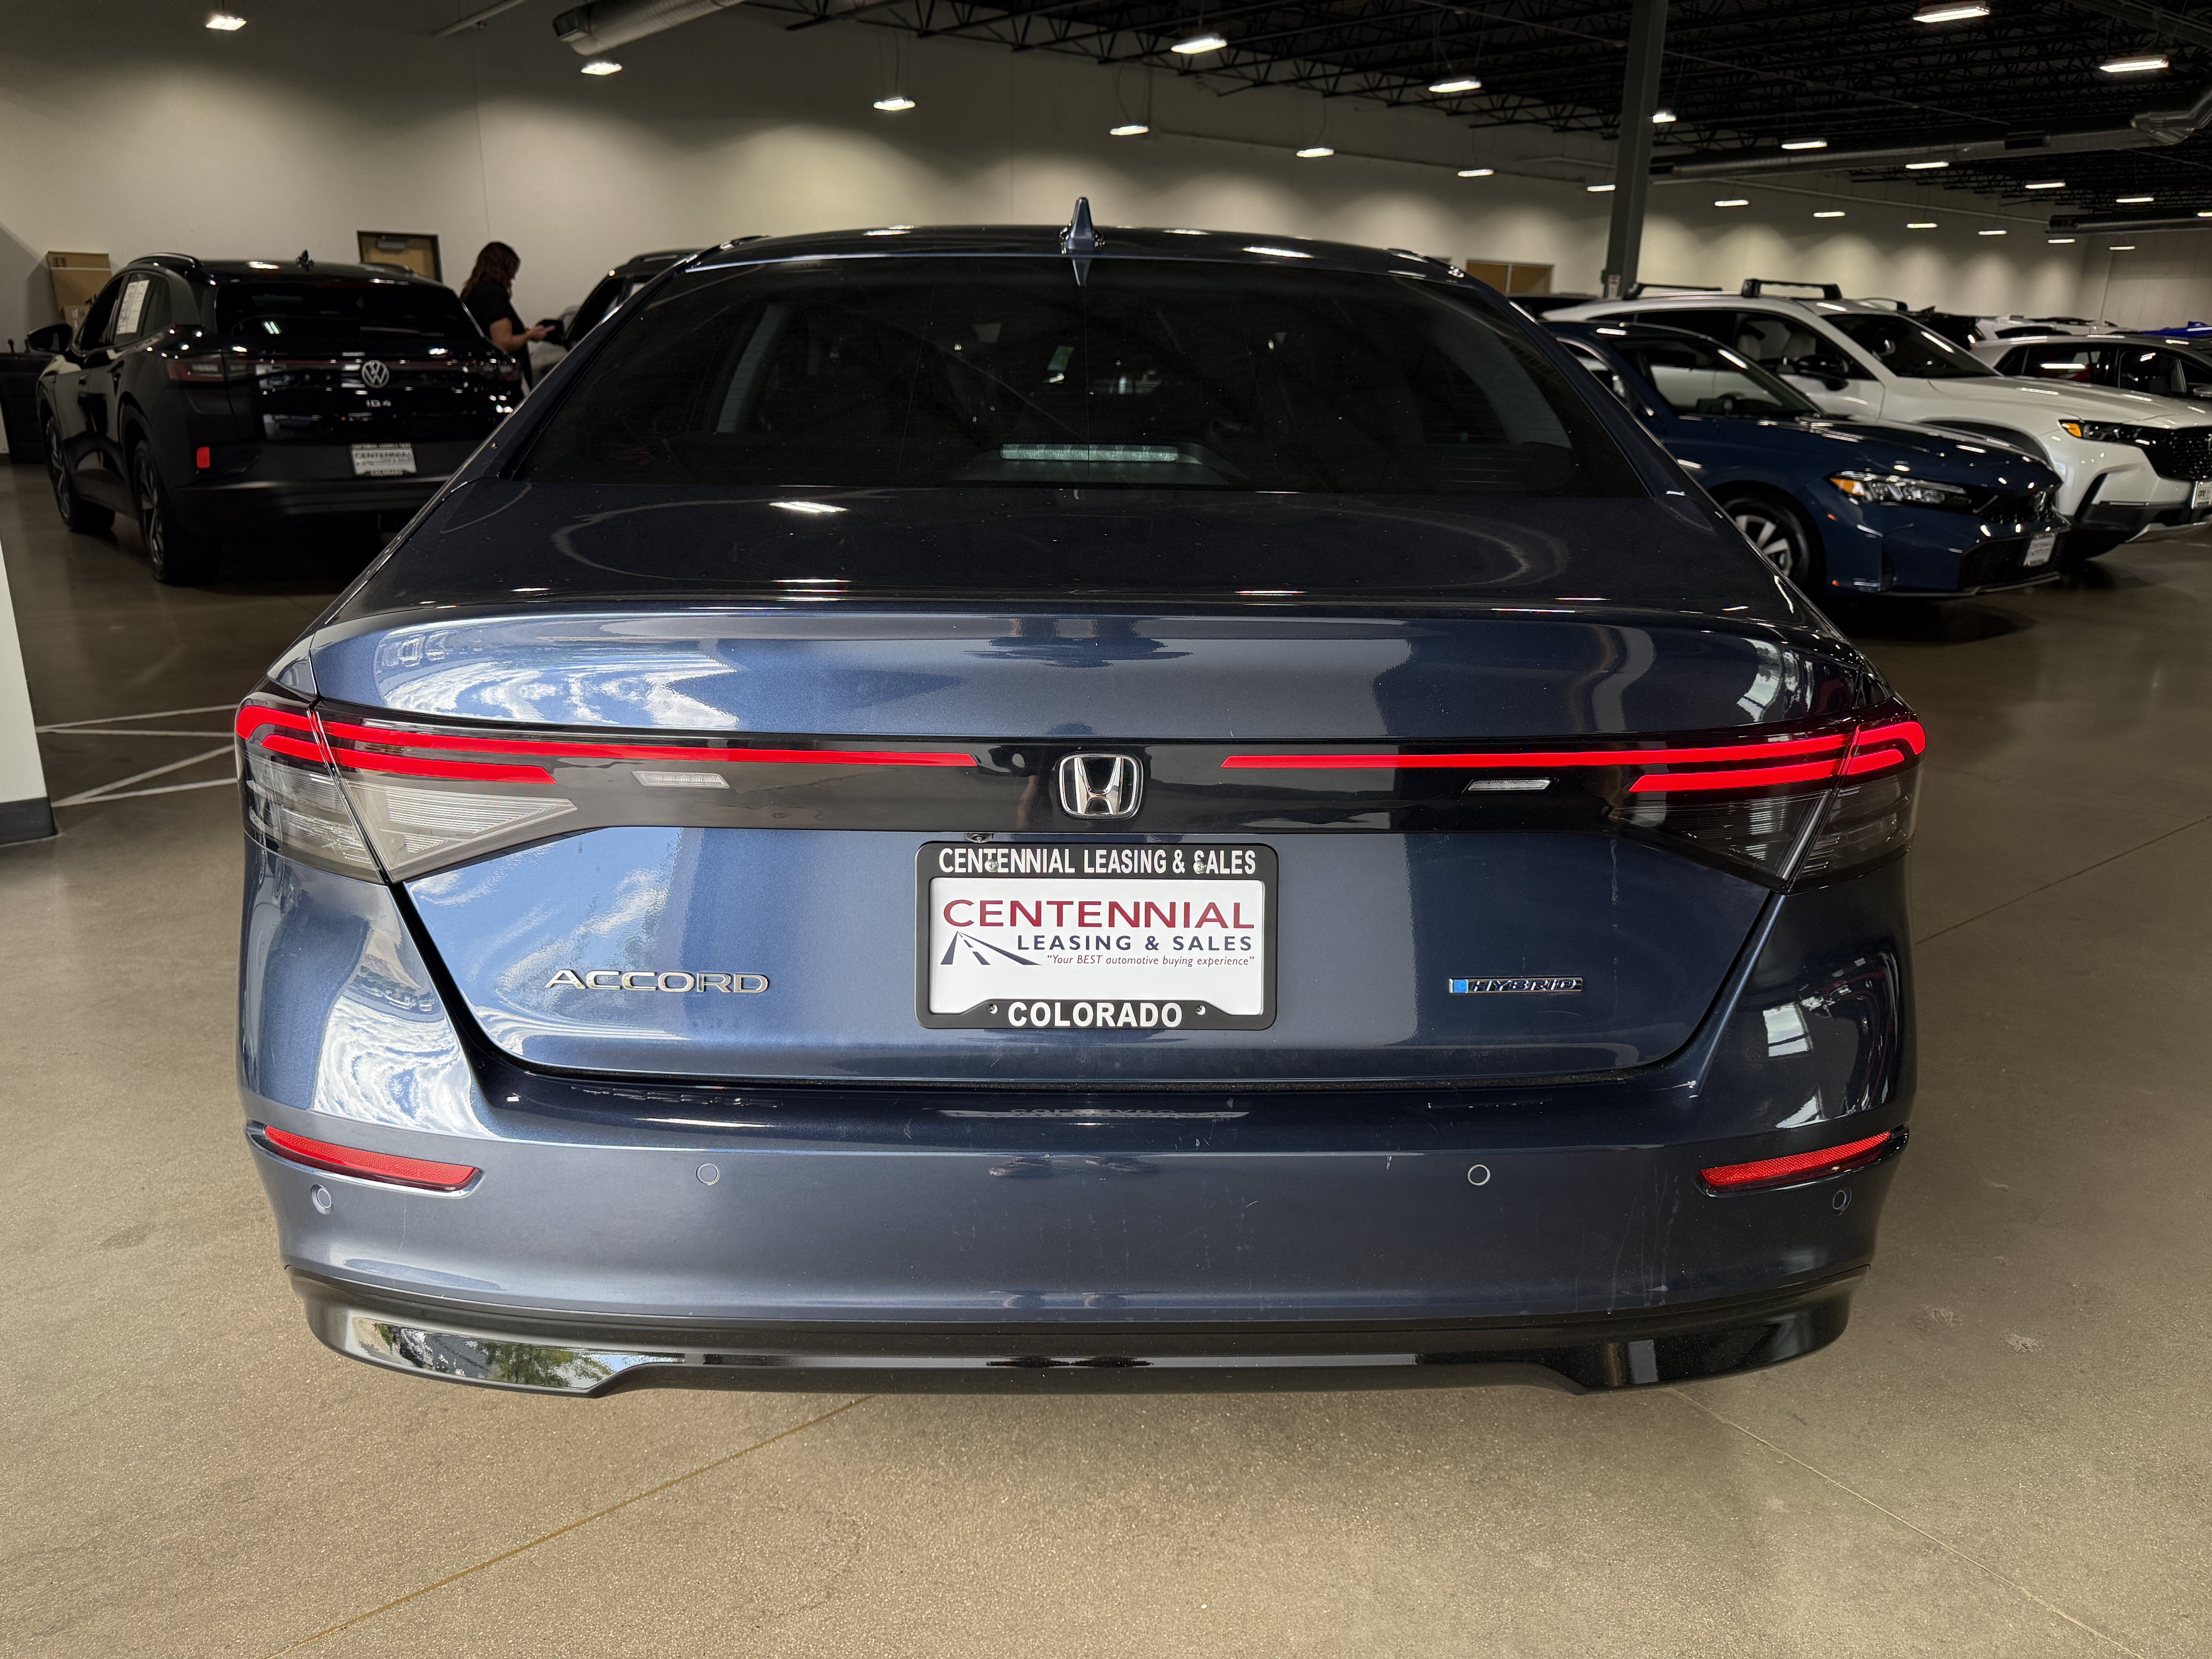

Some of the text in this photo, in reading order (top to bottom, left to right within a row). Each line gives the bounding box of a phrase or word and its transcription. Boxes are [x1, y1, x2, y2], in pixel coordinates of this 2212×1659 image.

[362, 360, 389, 388] VW
[939, 848, 1255, 874] CENTENNIAL LEASING & SALES
[943, 899, 1254, 929] CENTENNIAL
[1017, 935, 1252, 951] LEASING & SALES
[1077, 955, 1103, 964] BEST
[1106, 956, 1159, 965] automotive
[1162, 955, 1194, 967] buying
[544, 969, 769, 993] ACCORD
[1470, 979, 1577, 991] HYBRID
[1008, 1001, 1183, 1028] COLORADO
